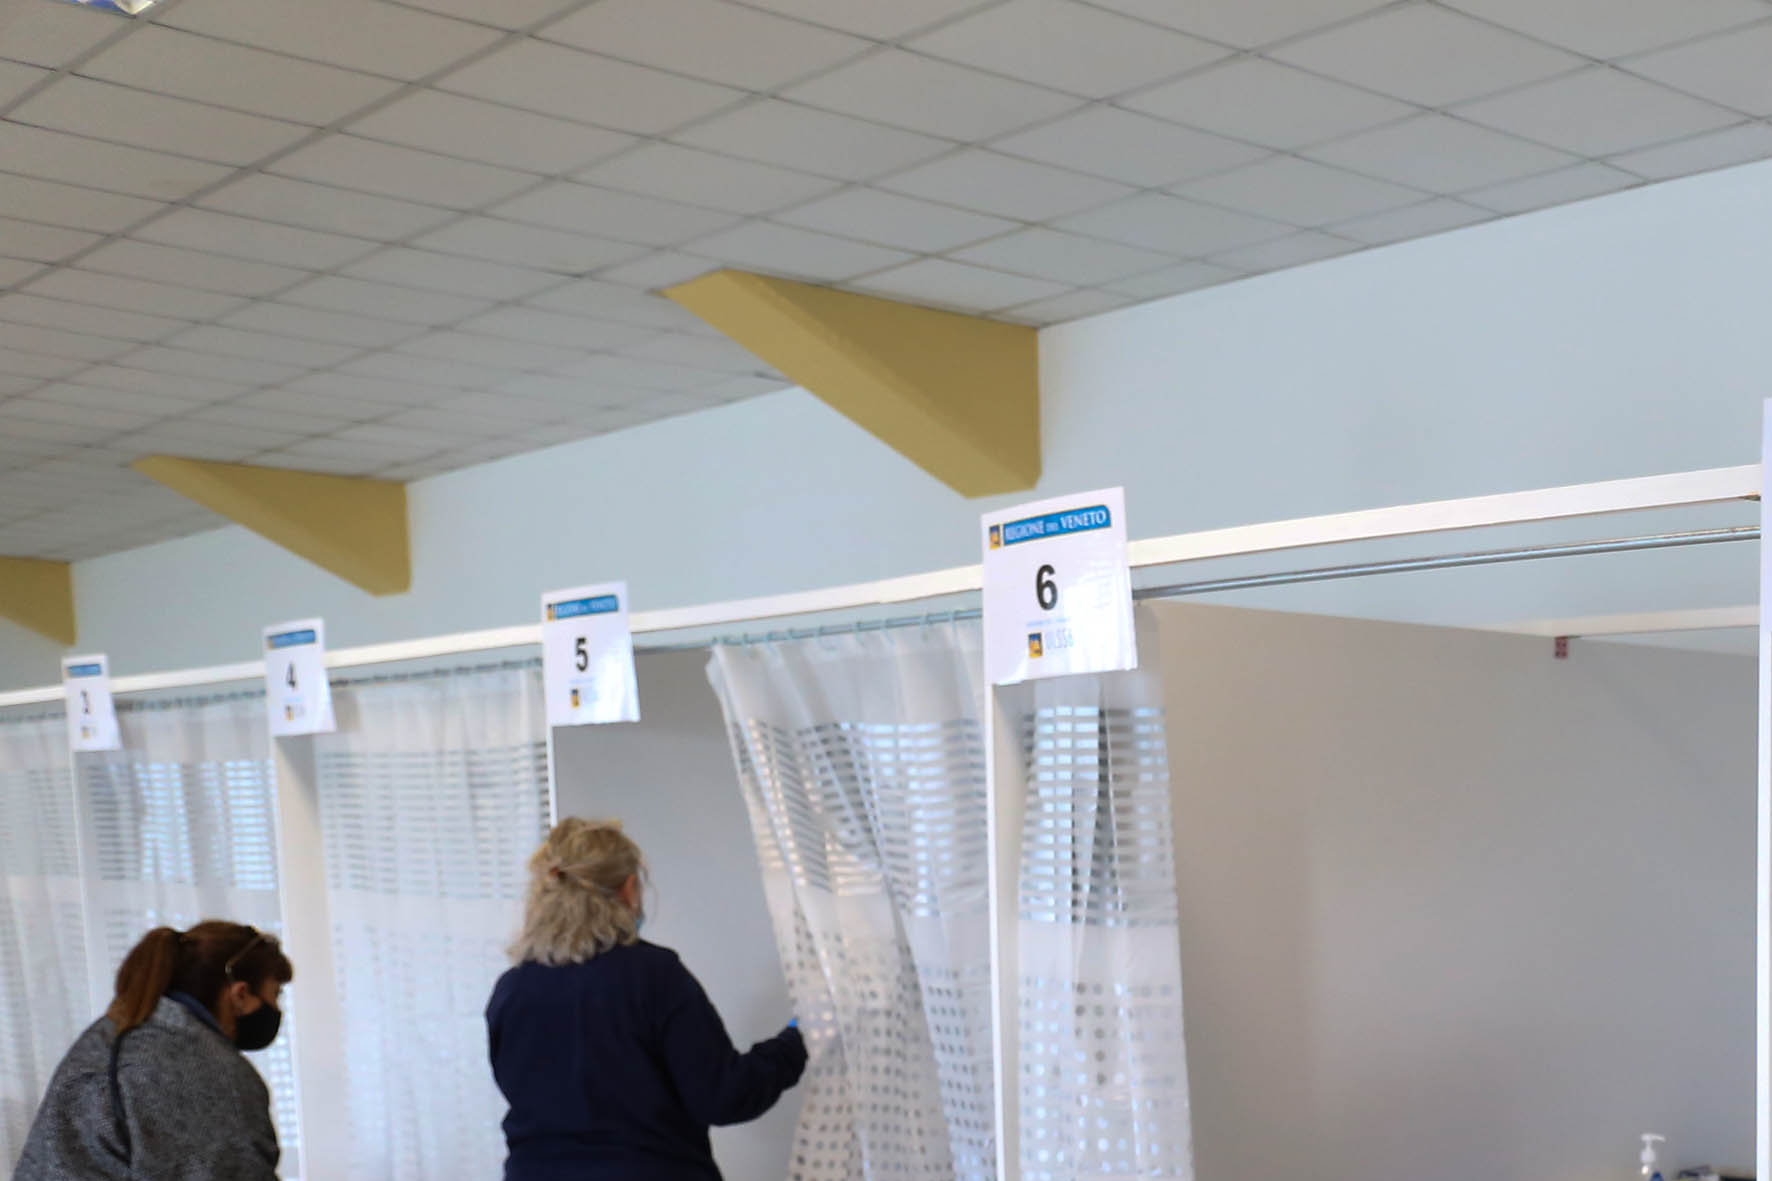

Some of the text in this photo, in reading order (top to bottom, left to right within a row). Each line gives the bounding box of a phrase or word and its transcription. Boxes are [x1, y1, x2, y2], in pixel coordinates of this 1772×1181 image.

[1060, 510, 1107, 529] VENETO
[1036, 564, 1058, 611] 6
[575, 637, 588, 672] 5
[286, 662, 296, 690] 4
